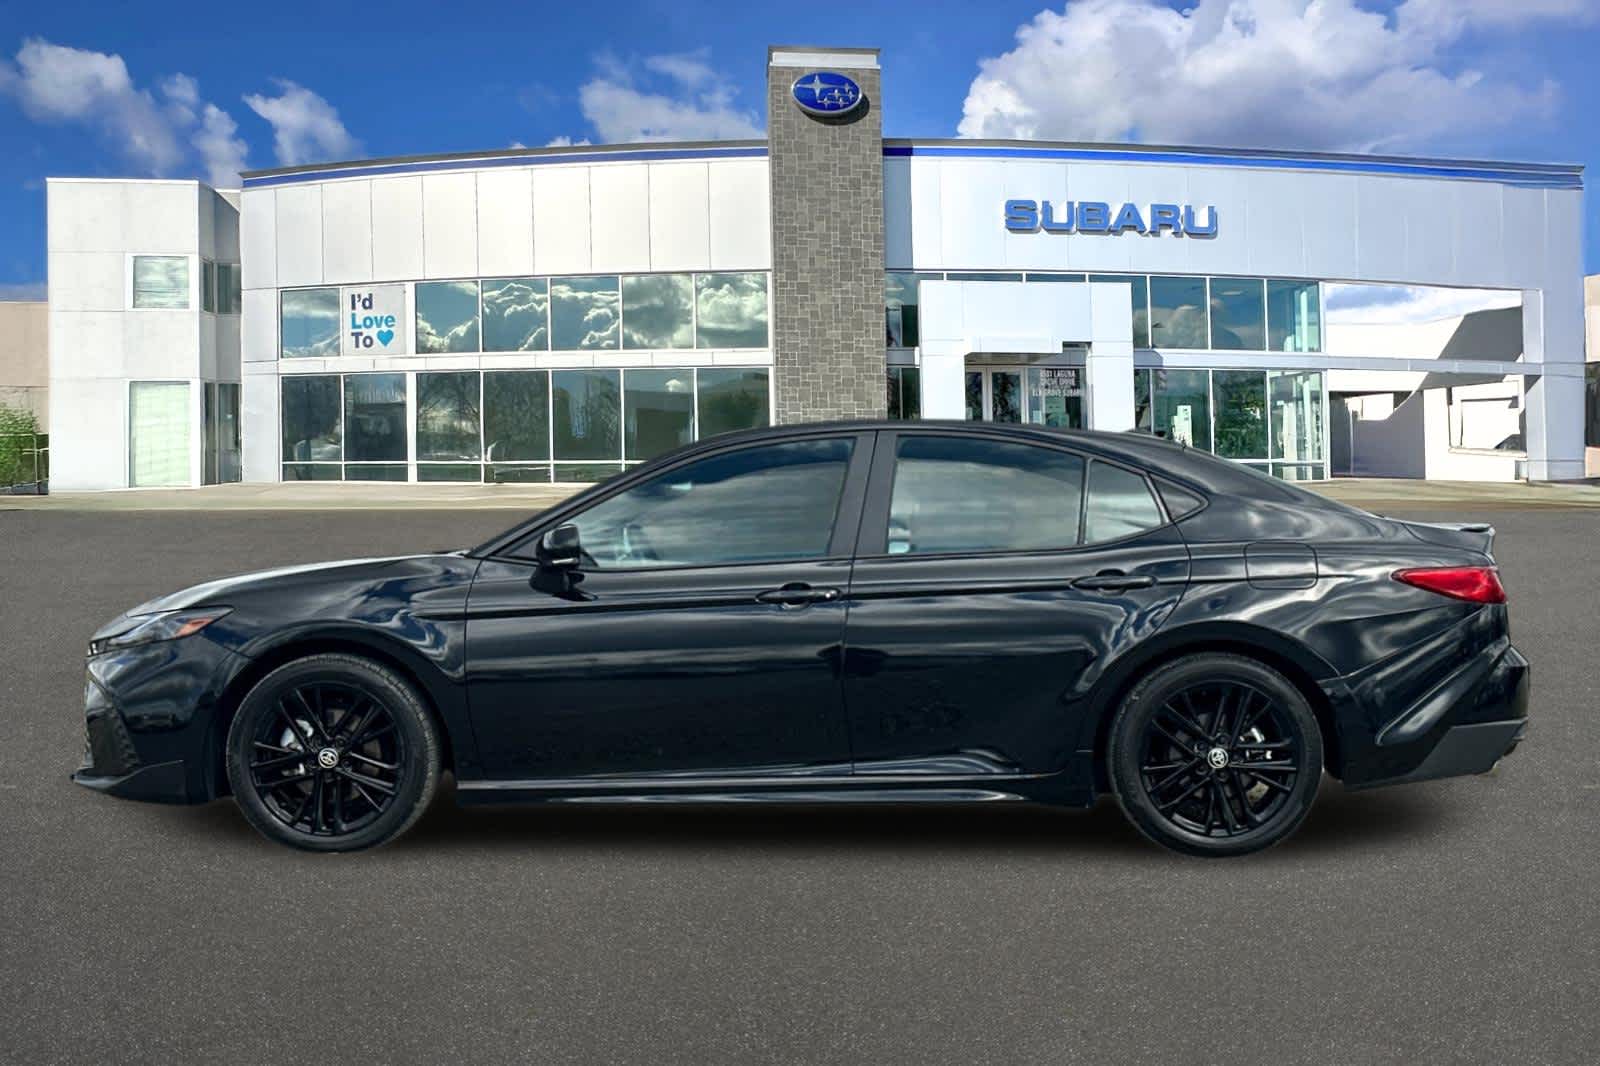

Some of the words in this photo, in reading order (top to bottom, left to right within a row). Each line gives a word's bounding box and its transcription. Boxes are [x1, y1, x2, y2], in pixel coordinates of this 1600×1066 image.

[1005, 199, 1216, 238] SUBARU
[351, 312, 396, 329] Love
[351, 331, 374, 349] To
